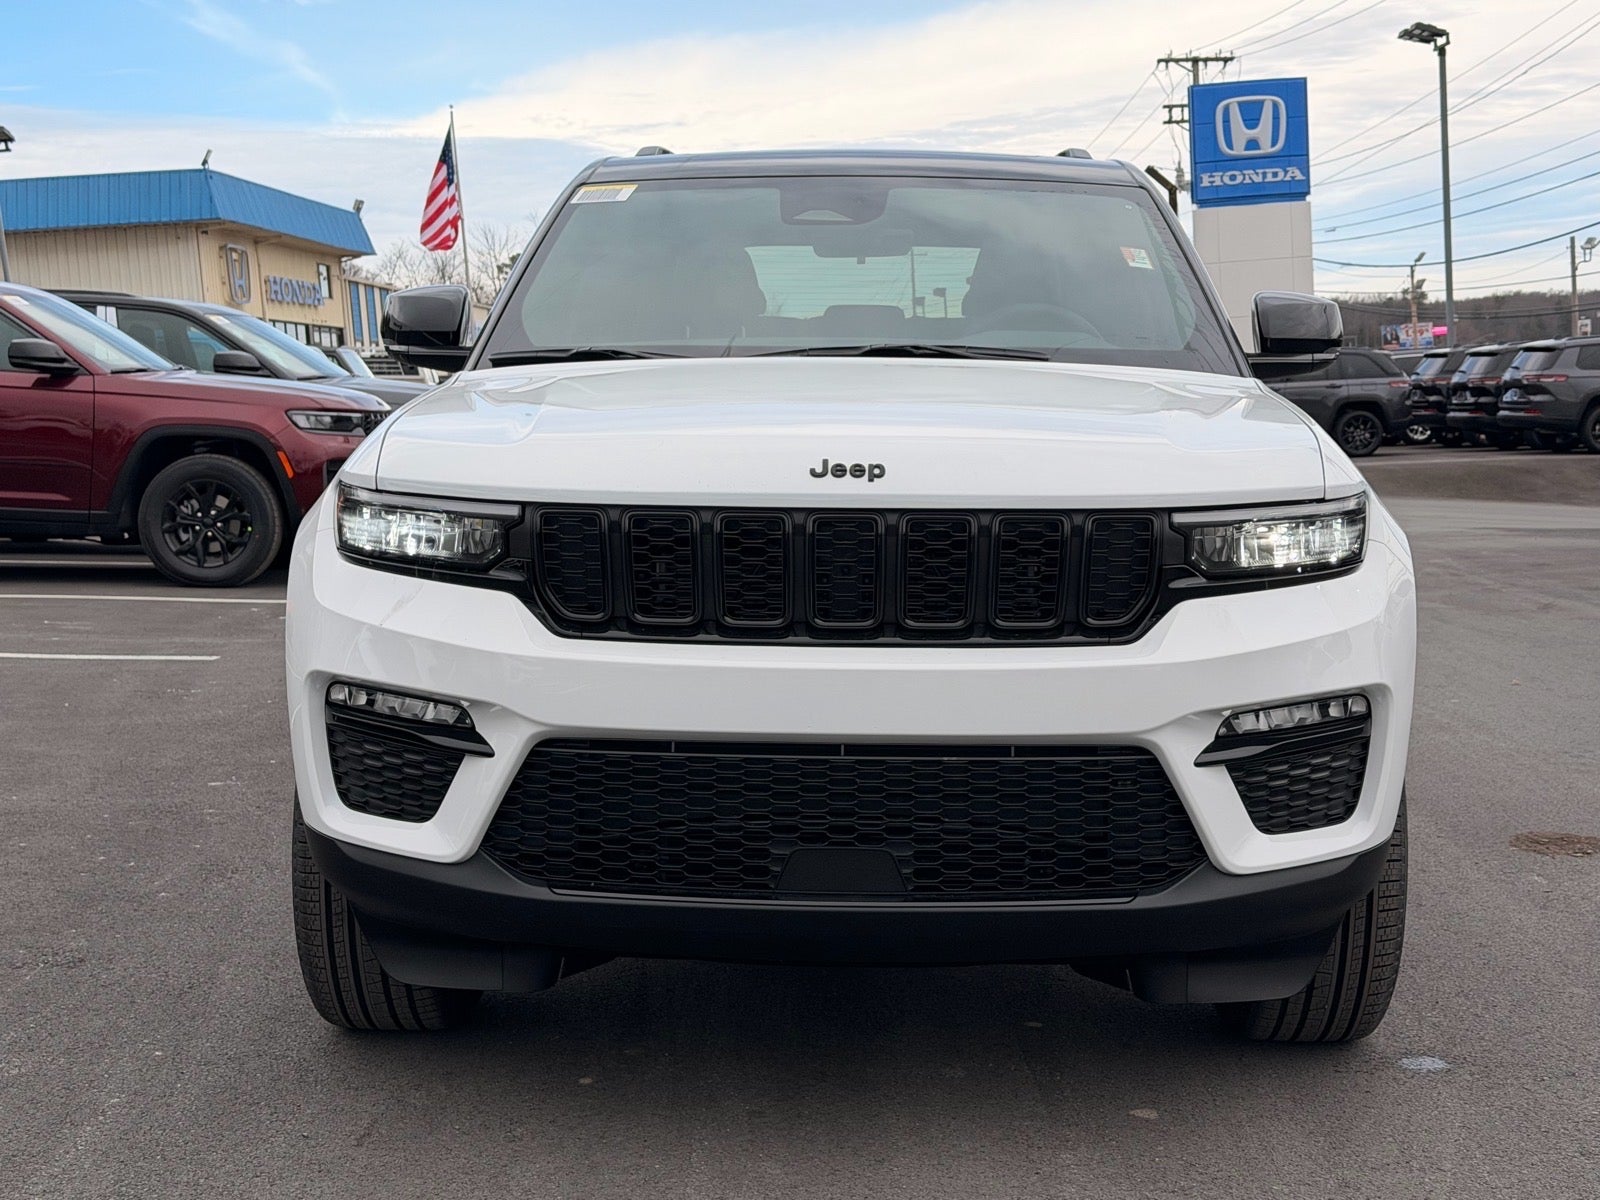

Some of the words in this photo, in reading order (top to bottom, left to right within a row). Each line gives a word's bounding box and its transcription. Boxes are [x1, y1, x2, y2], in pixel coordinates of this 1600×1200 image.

[1199, 166, 1307, 189] HONDA
[268, 275, 325, 306] HONDA
[809, 458, 887, 482] Jeep
